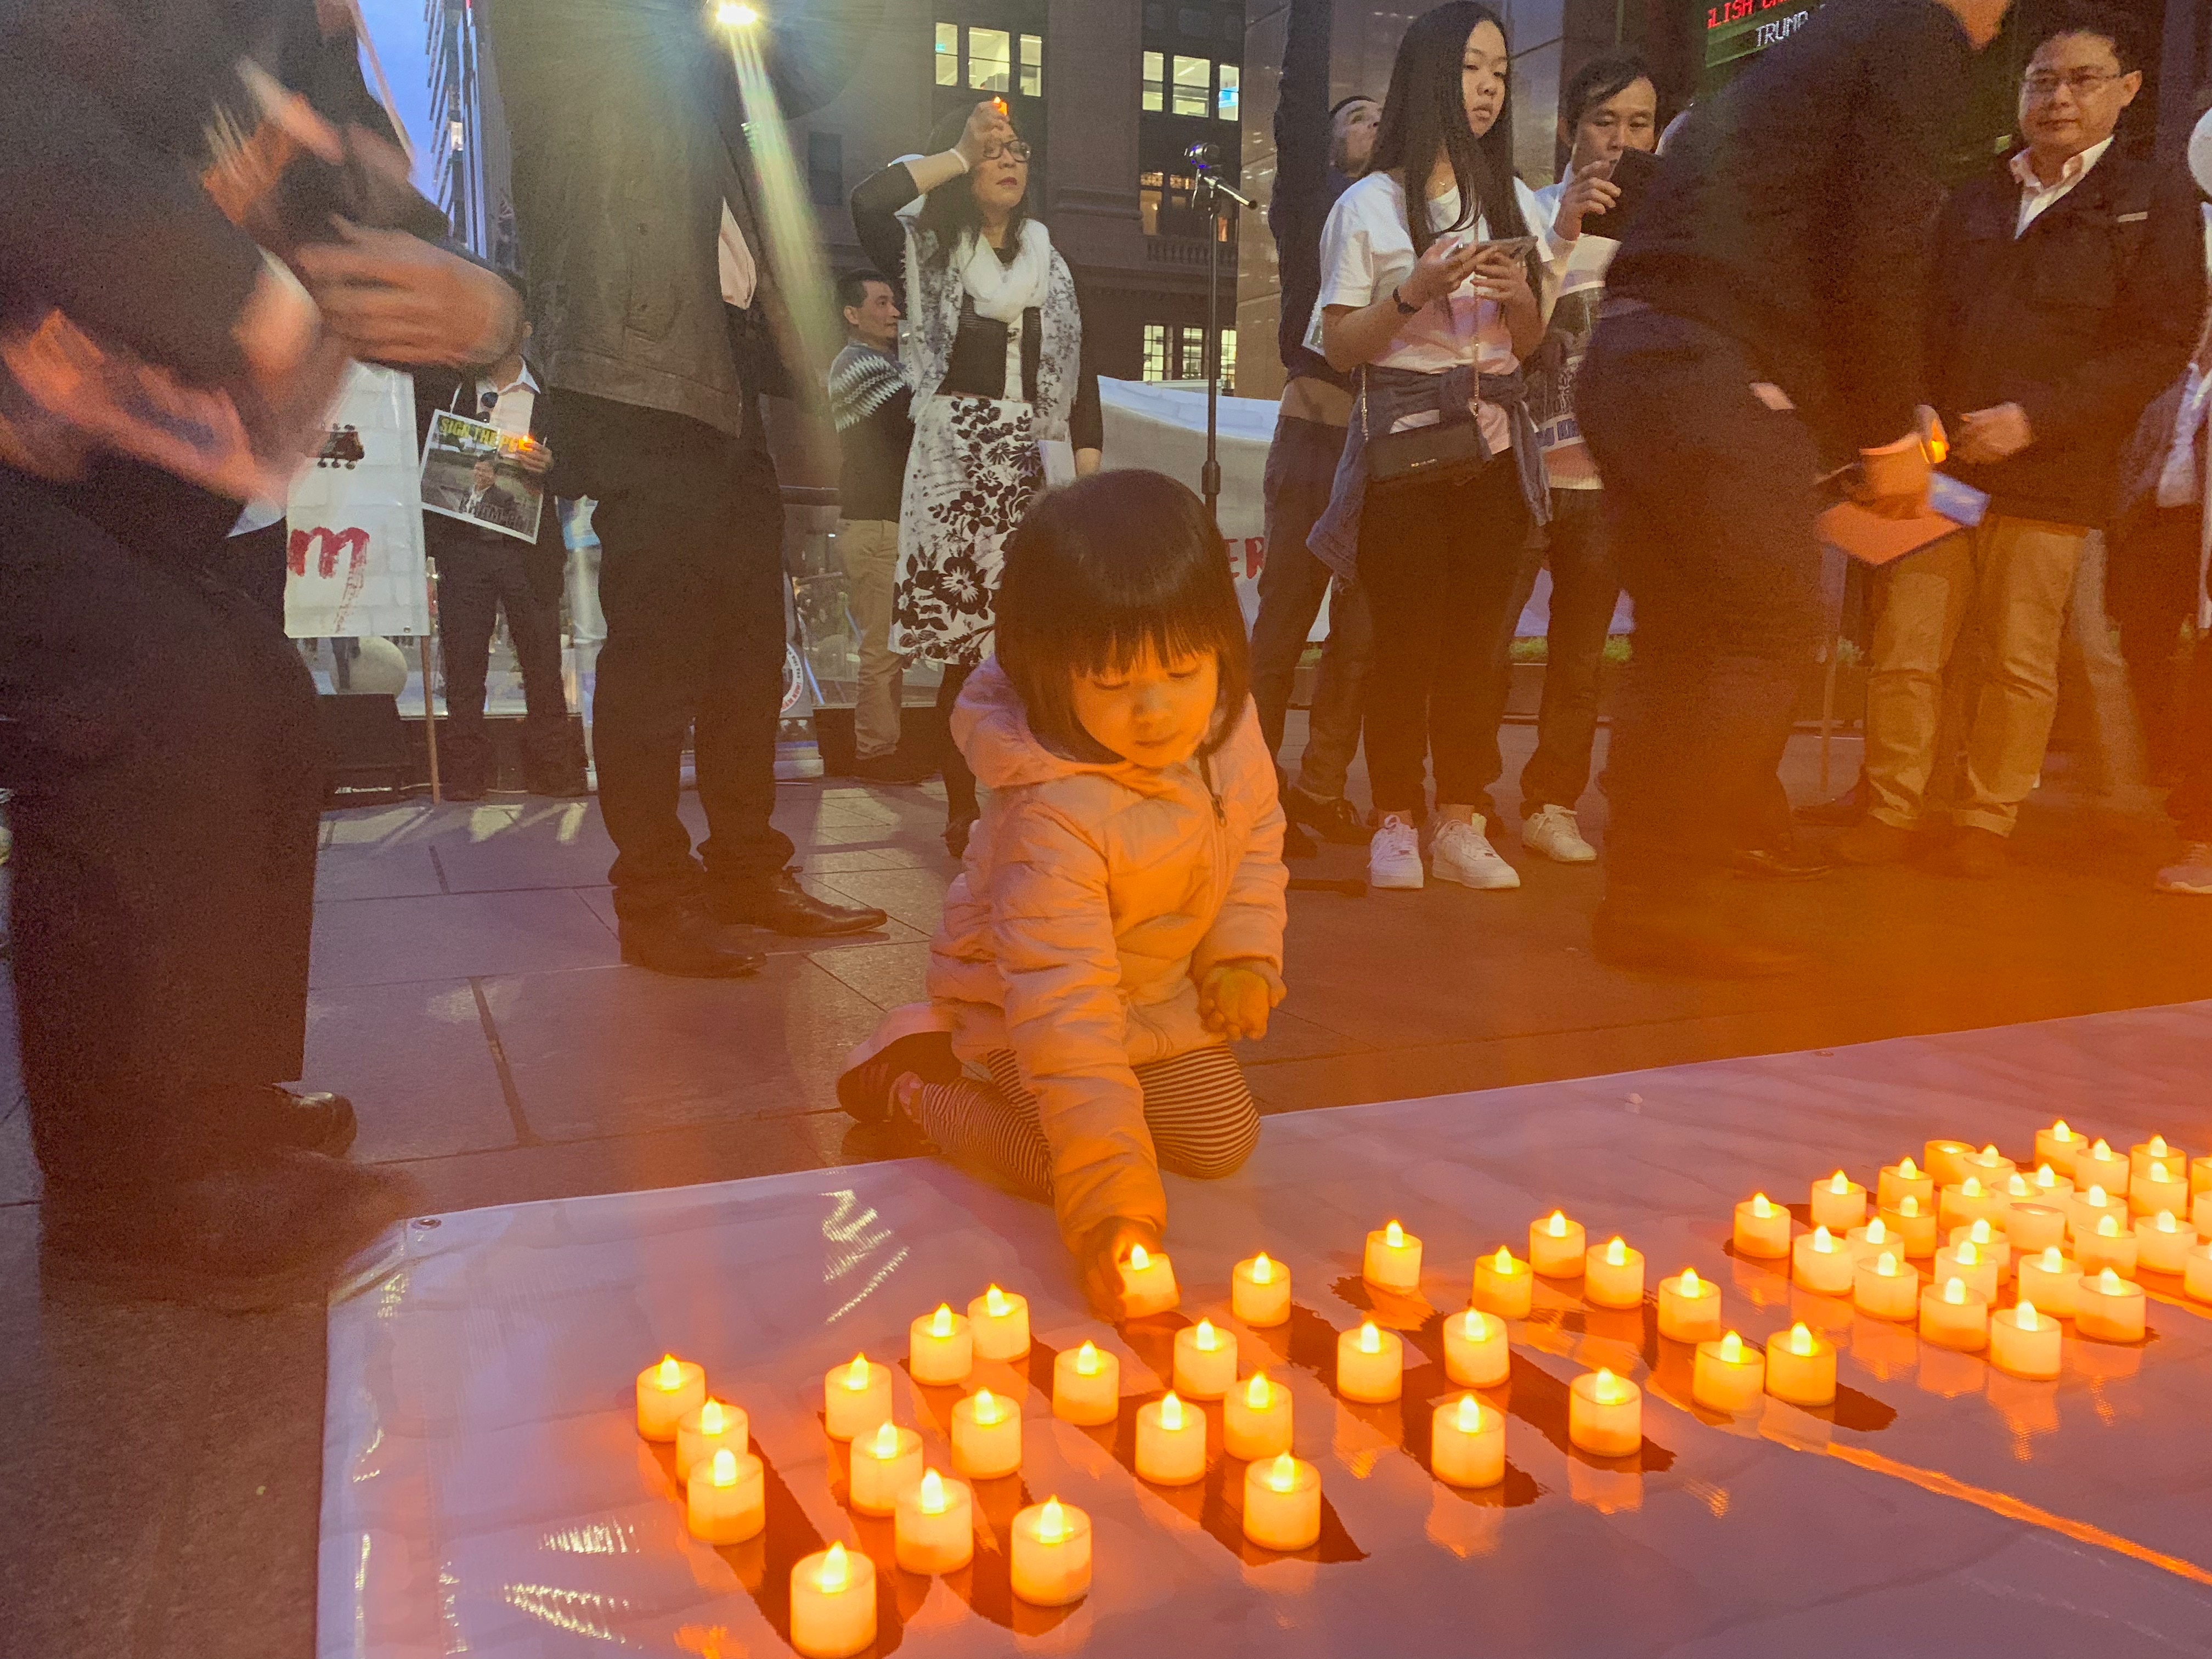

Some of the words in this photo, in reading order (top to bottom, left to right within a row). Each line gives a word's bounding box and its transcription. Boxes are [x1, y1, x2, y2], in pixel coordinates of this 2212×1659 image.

[1707, 0, 1753, 29] LISH
[1756, 10, 1809, 47] TRUMP
[441, 417, 471, 437] SIGN
